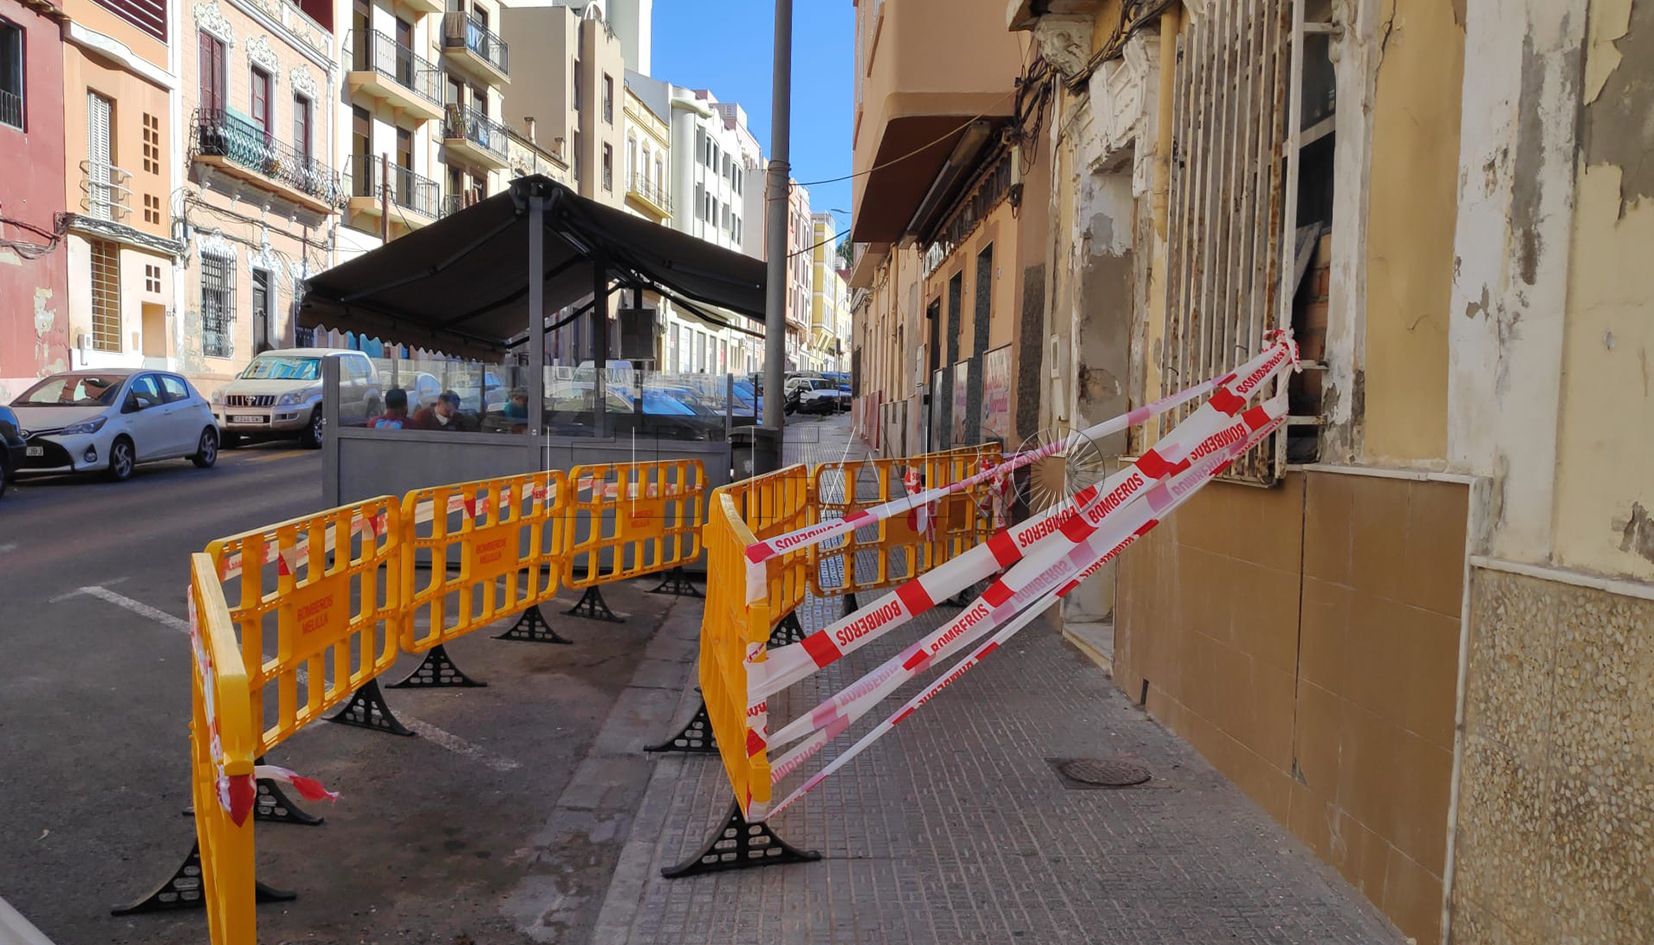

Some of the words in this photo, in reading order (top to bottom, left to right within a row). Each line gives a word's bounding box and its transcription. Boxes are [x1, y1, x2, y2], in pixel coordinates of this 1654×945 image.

[1087, 472, 1145, 524] BOMBEROS
[297, 594, 334, 622] BOMBEROS
[302, 612, 329, 635] MELILLA
[835, 599, 902, 647] BOMBEROS
